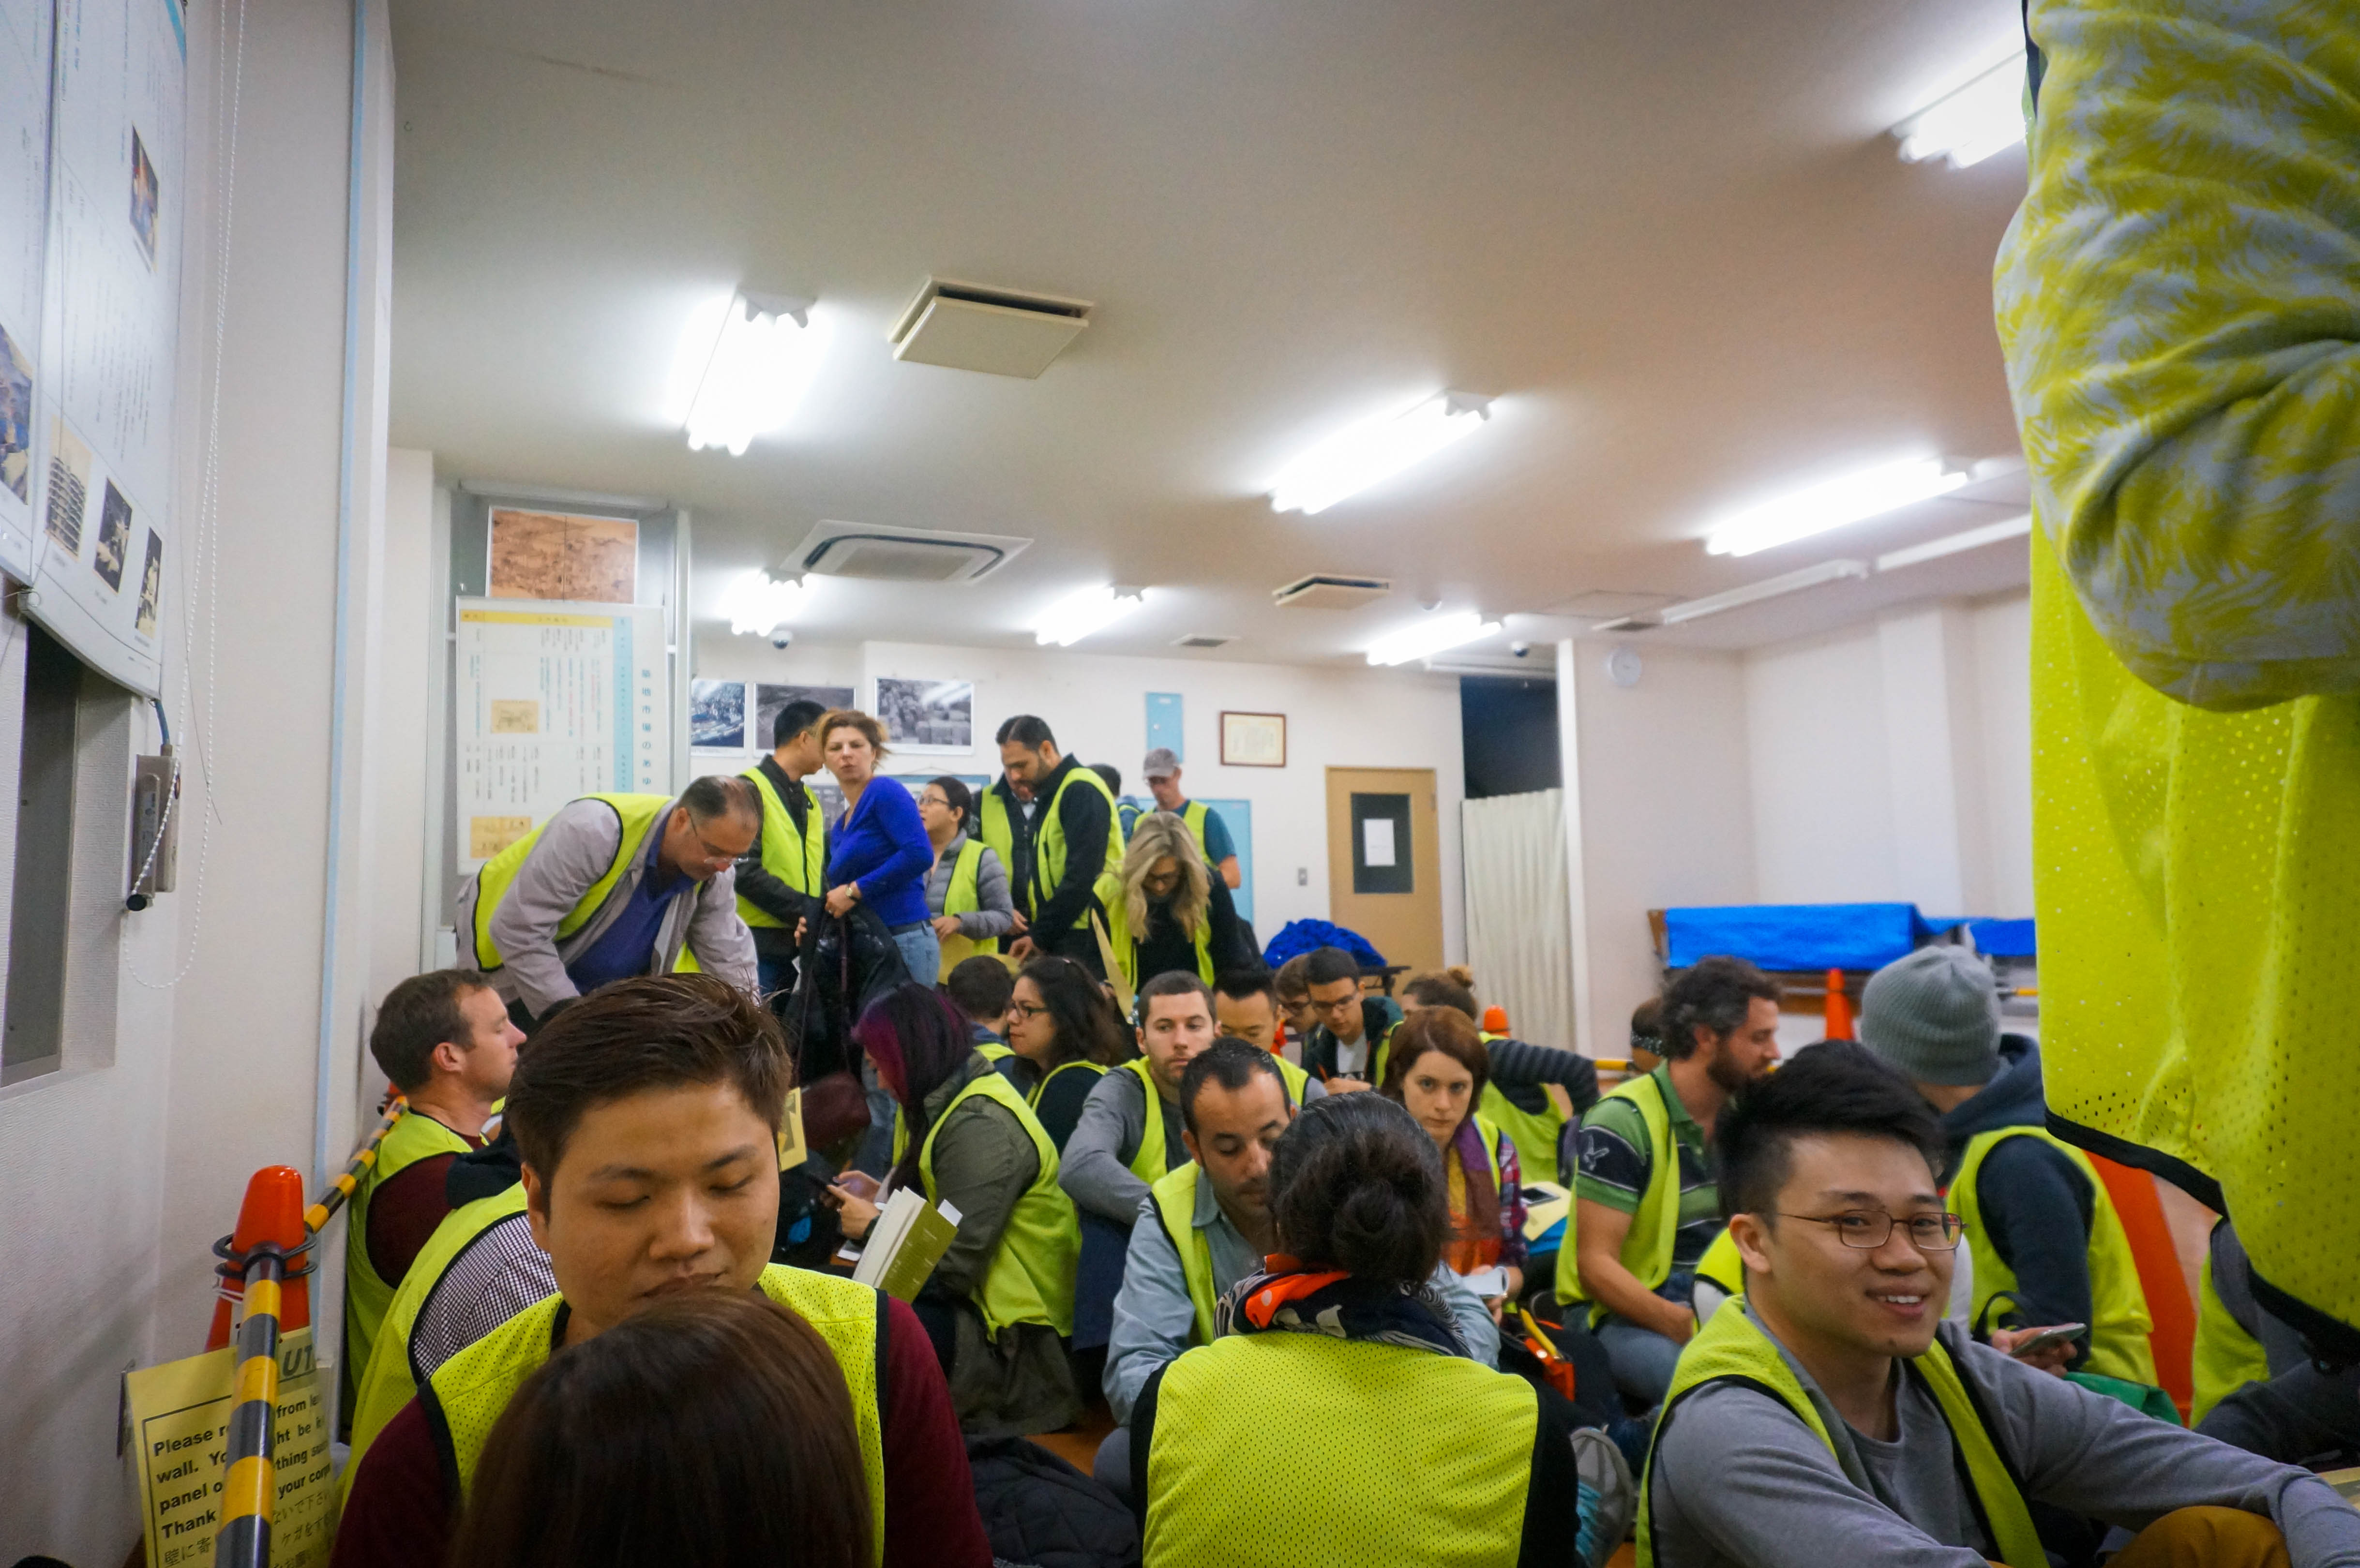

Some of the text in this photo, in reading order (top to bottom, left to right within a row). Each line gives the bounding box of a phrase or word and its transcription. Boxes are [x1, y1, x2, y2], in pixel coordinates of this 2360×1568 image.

[153, 1430, 213, 1457] Please
[276, 1400, 306, 1419] from
[156, 1460, 199, 1484] wall.
[298, 1424, 311, 1437] be
[159, 1482, 207, 1516] panel
[161, 1509, 217, 1539] Thank
[278, 1476, 306, 1500] your
